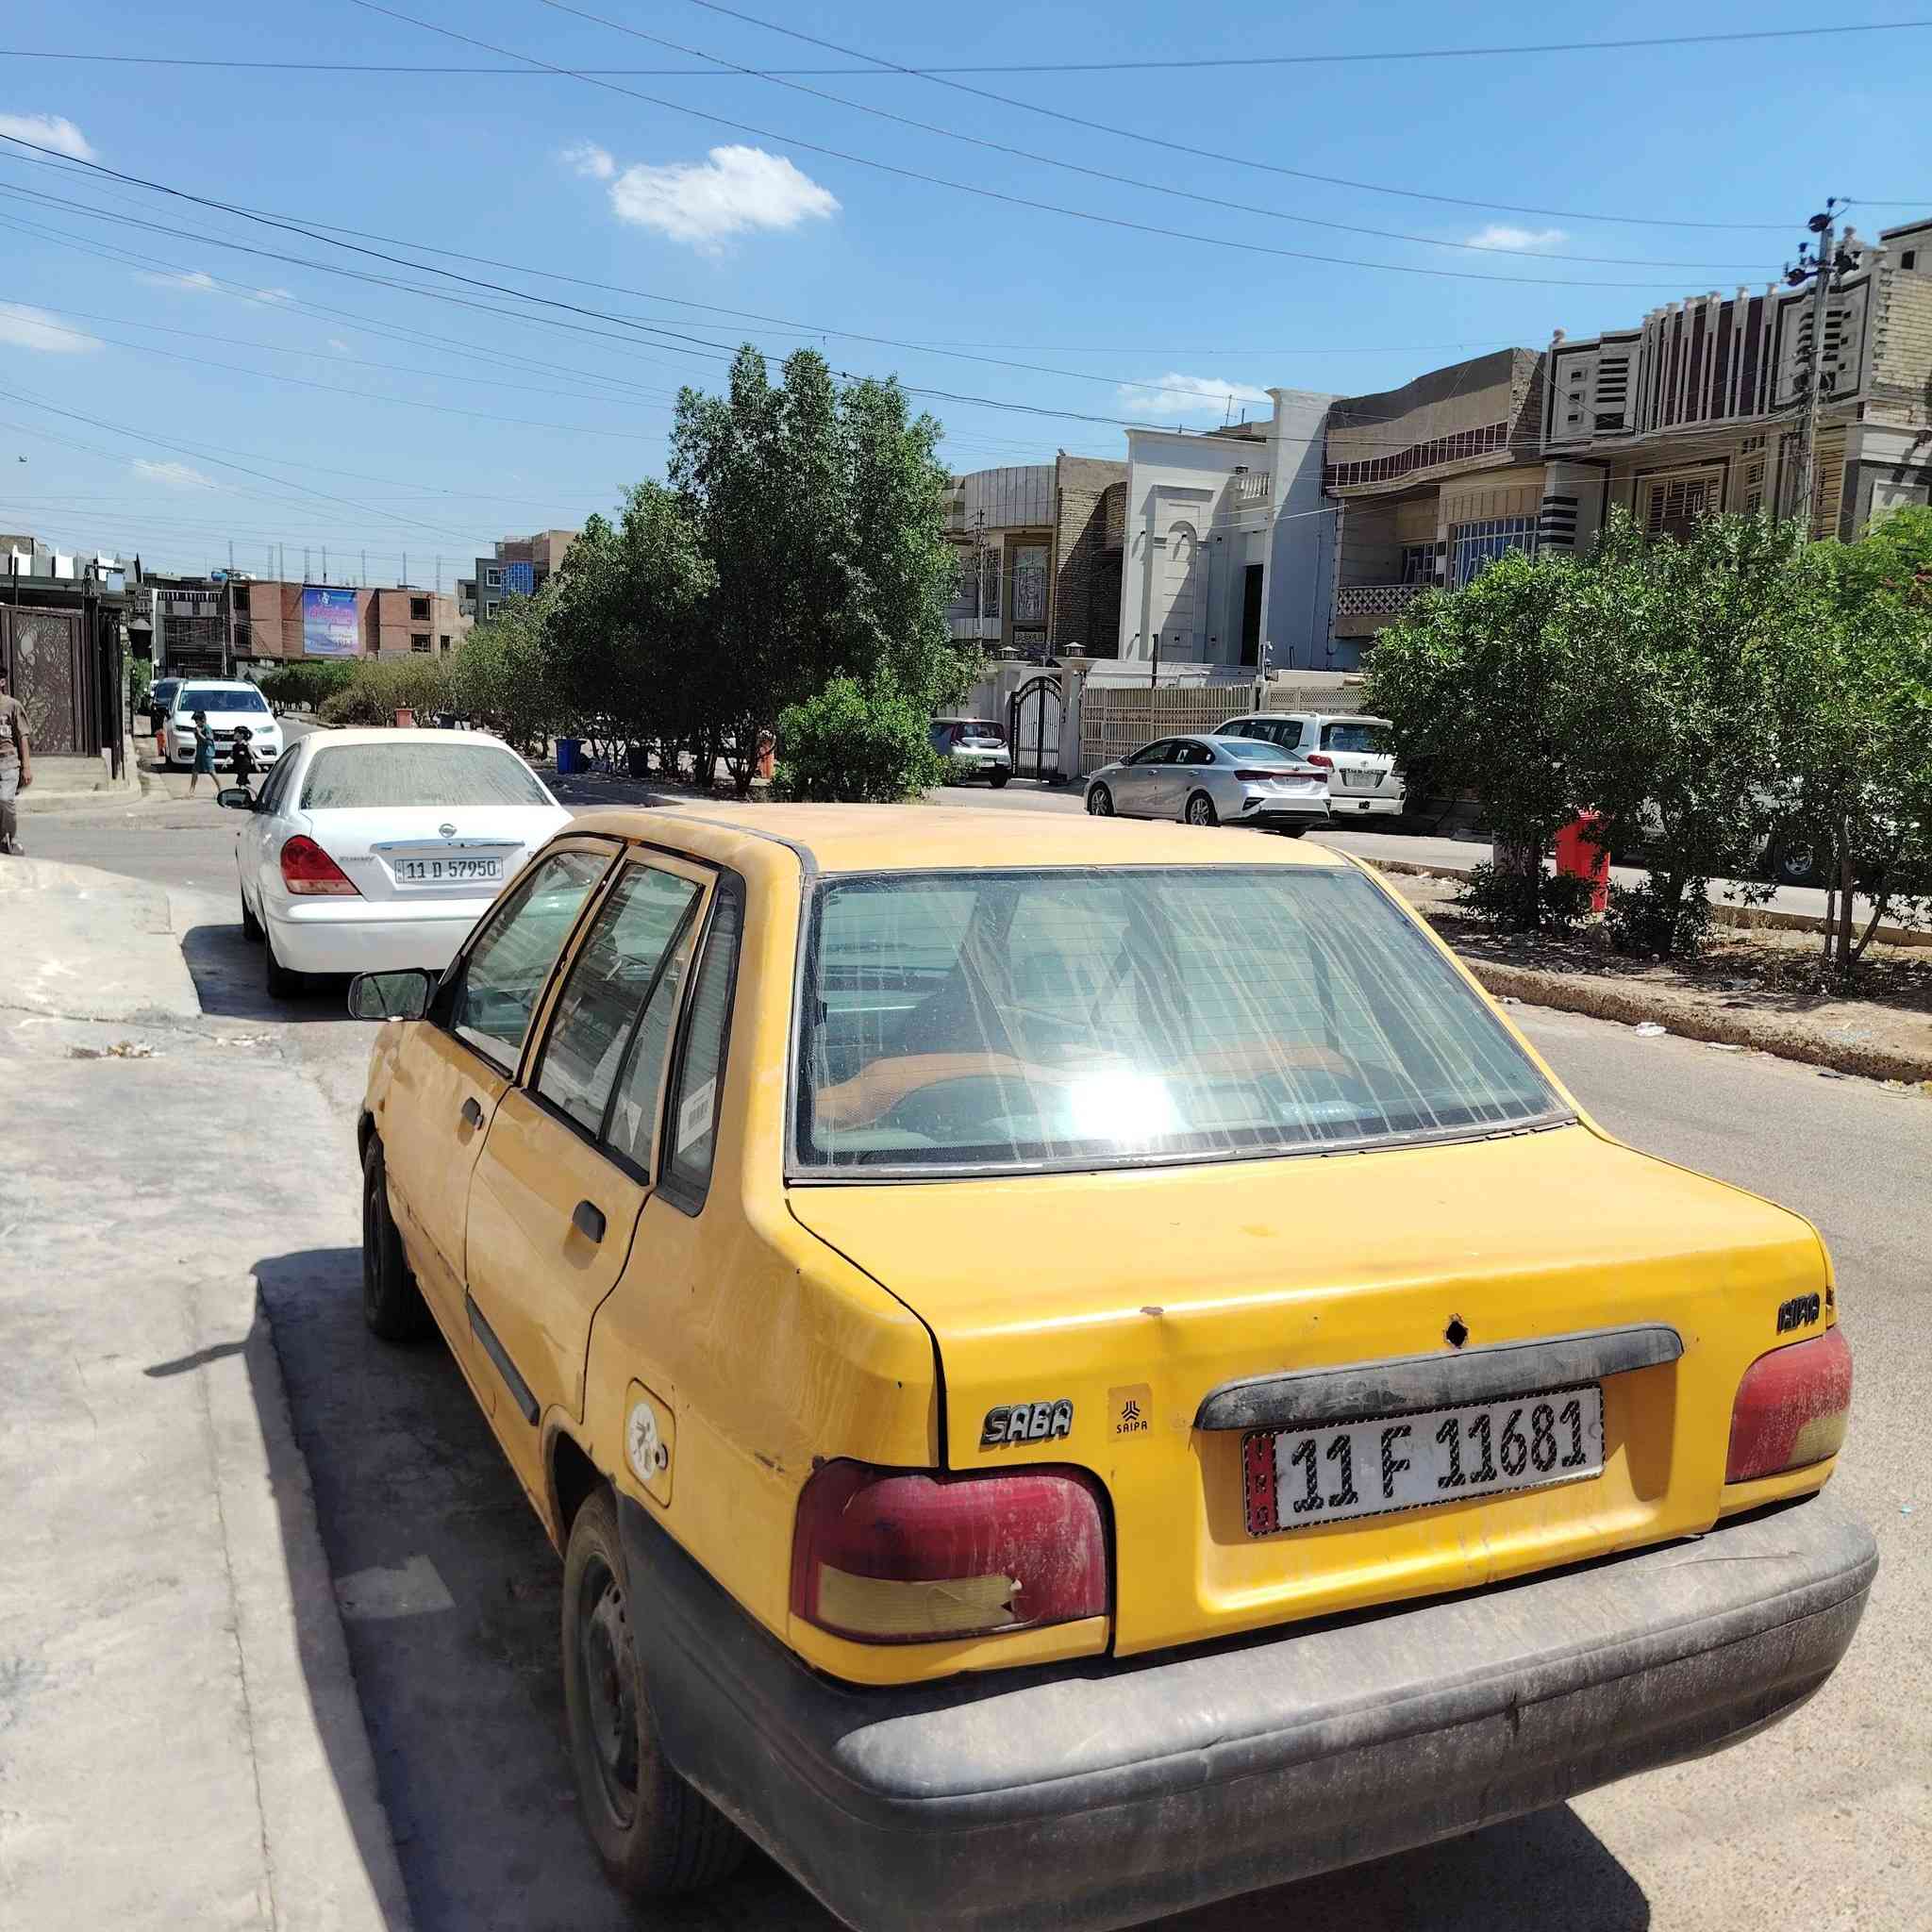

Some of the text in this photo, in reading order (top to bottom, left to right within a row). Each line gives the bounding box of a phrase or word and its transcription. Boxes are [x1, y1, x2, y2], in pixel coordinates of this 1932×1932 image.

[407, 862, 425, 878] 11
[432, 861, 442, 878] D
[448, 859, 496, 878] 57950
[981, 1398, 1074, 1445] SABA
[1116, 1421, 1148, 1434] SAIPA
[1291, 1399, 1587, 1513] 11 F 11681
